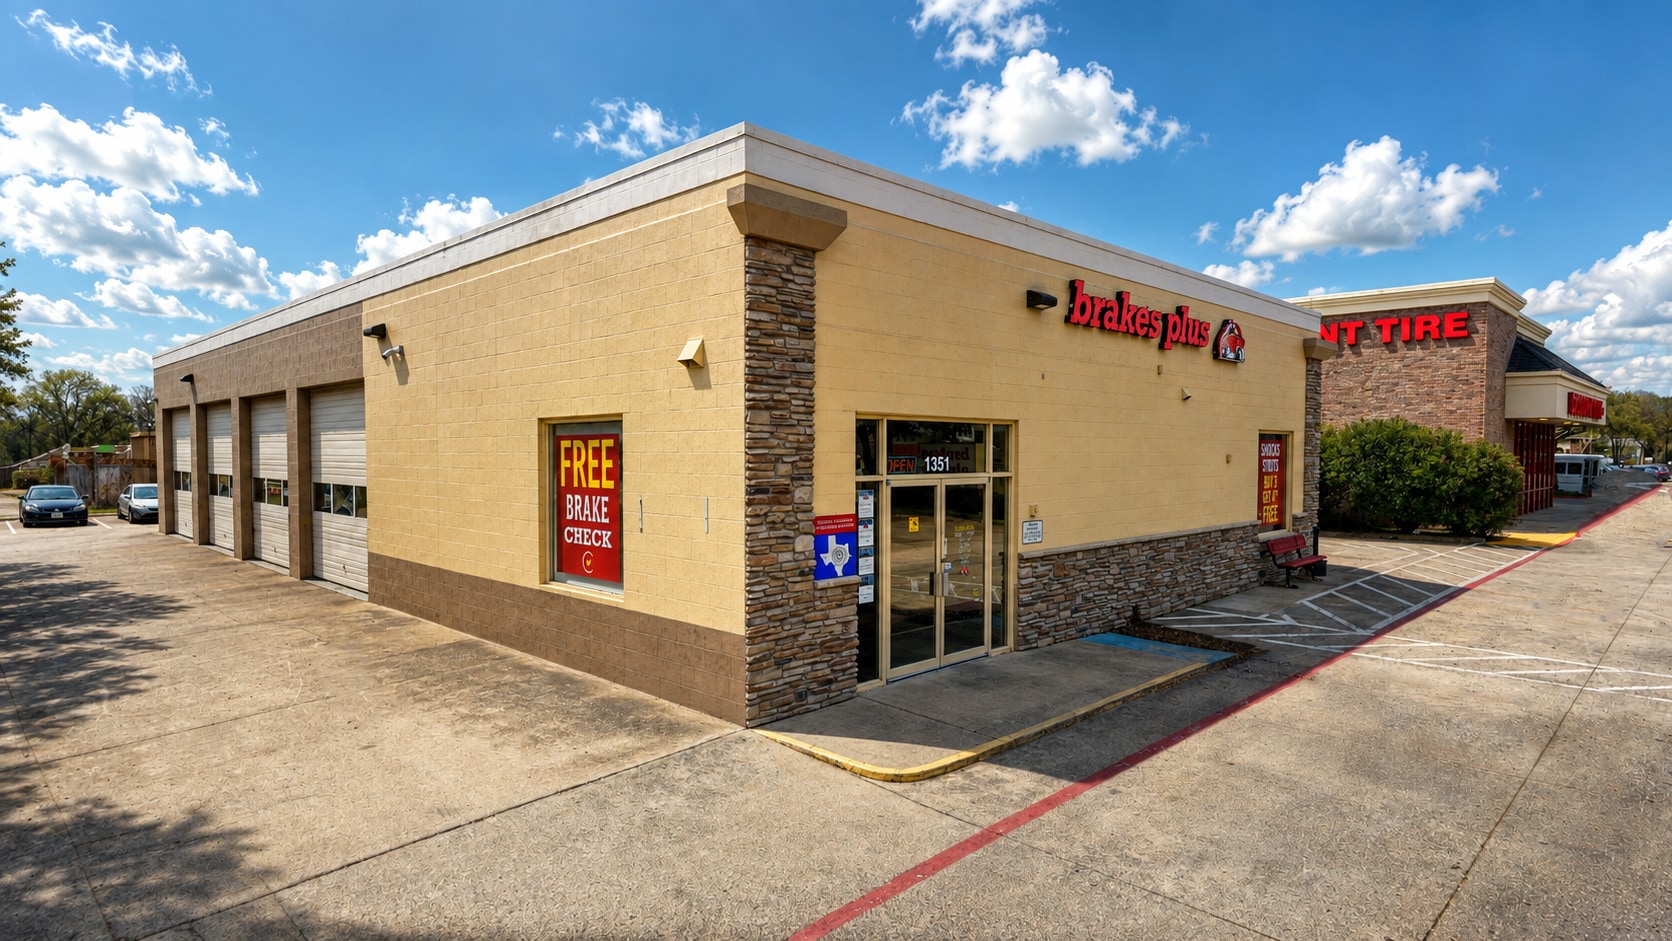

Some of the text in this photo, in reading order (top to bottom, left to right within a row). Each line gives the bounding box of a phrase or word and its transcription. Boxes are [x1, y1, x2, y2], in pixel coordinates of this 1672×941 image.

[1067, 279, 1211, 350] brakes plus
[1375, 311, 1470, 344] TIRE
[560, 439, 615, 489] FREE
[924, 456, 950, 472] 1351
[565, 494, 610, 523] BRAKE
[1262, 505, 1279, 523] FREE
[564, 526, 612, 548] CHECK
